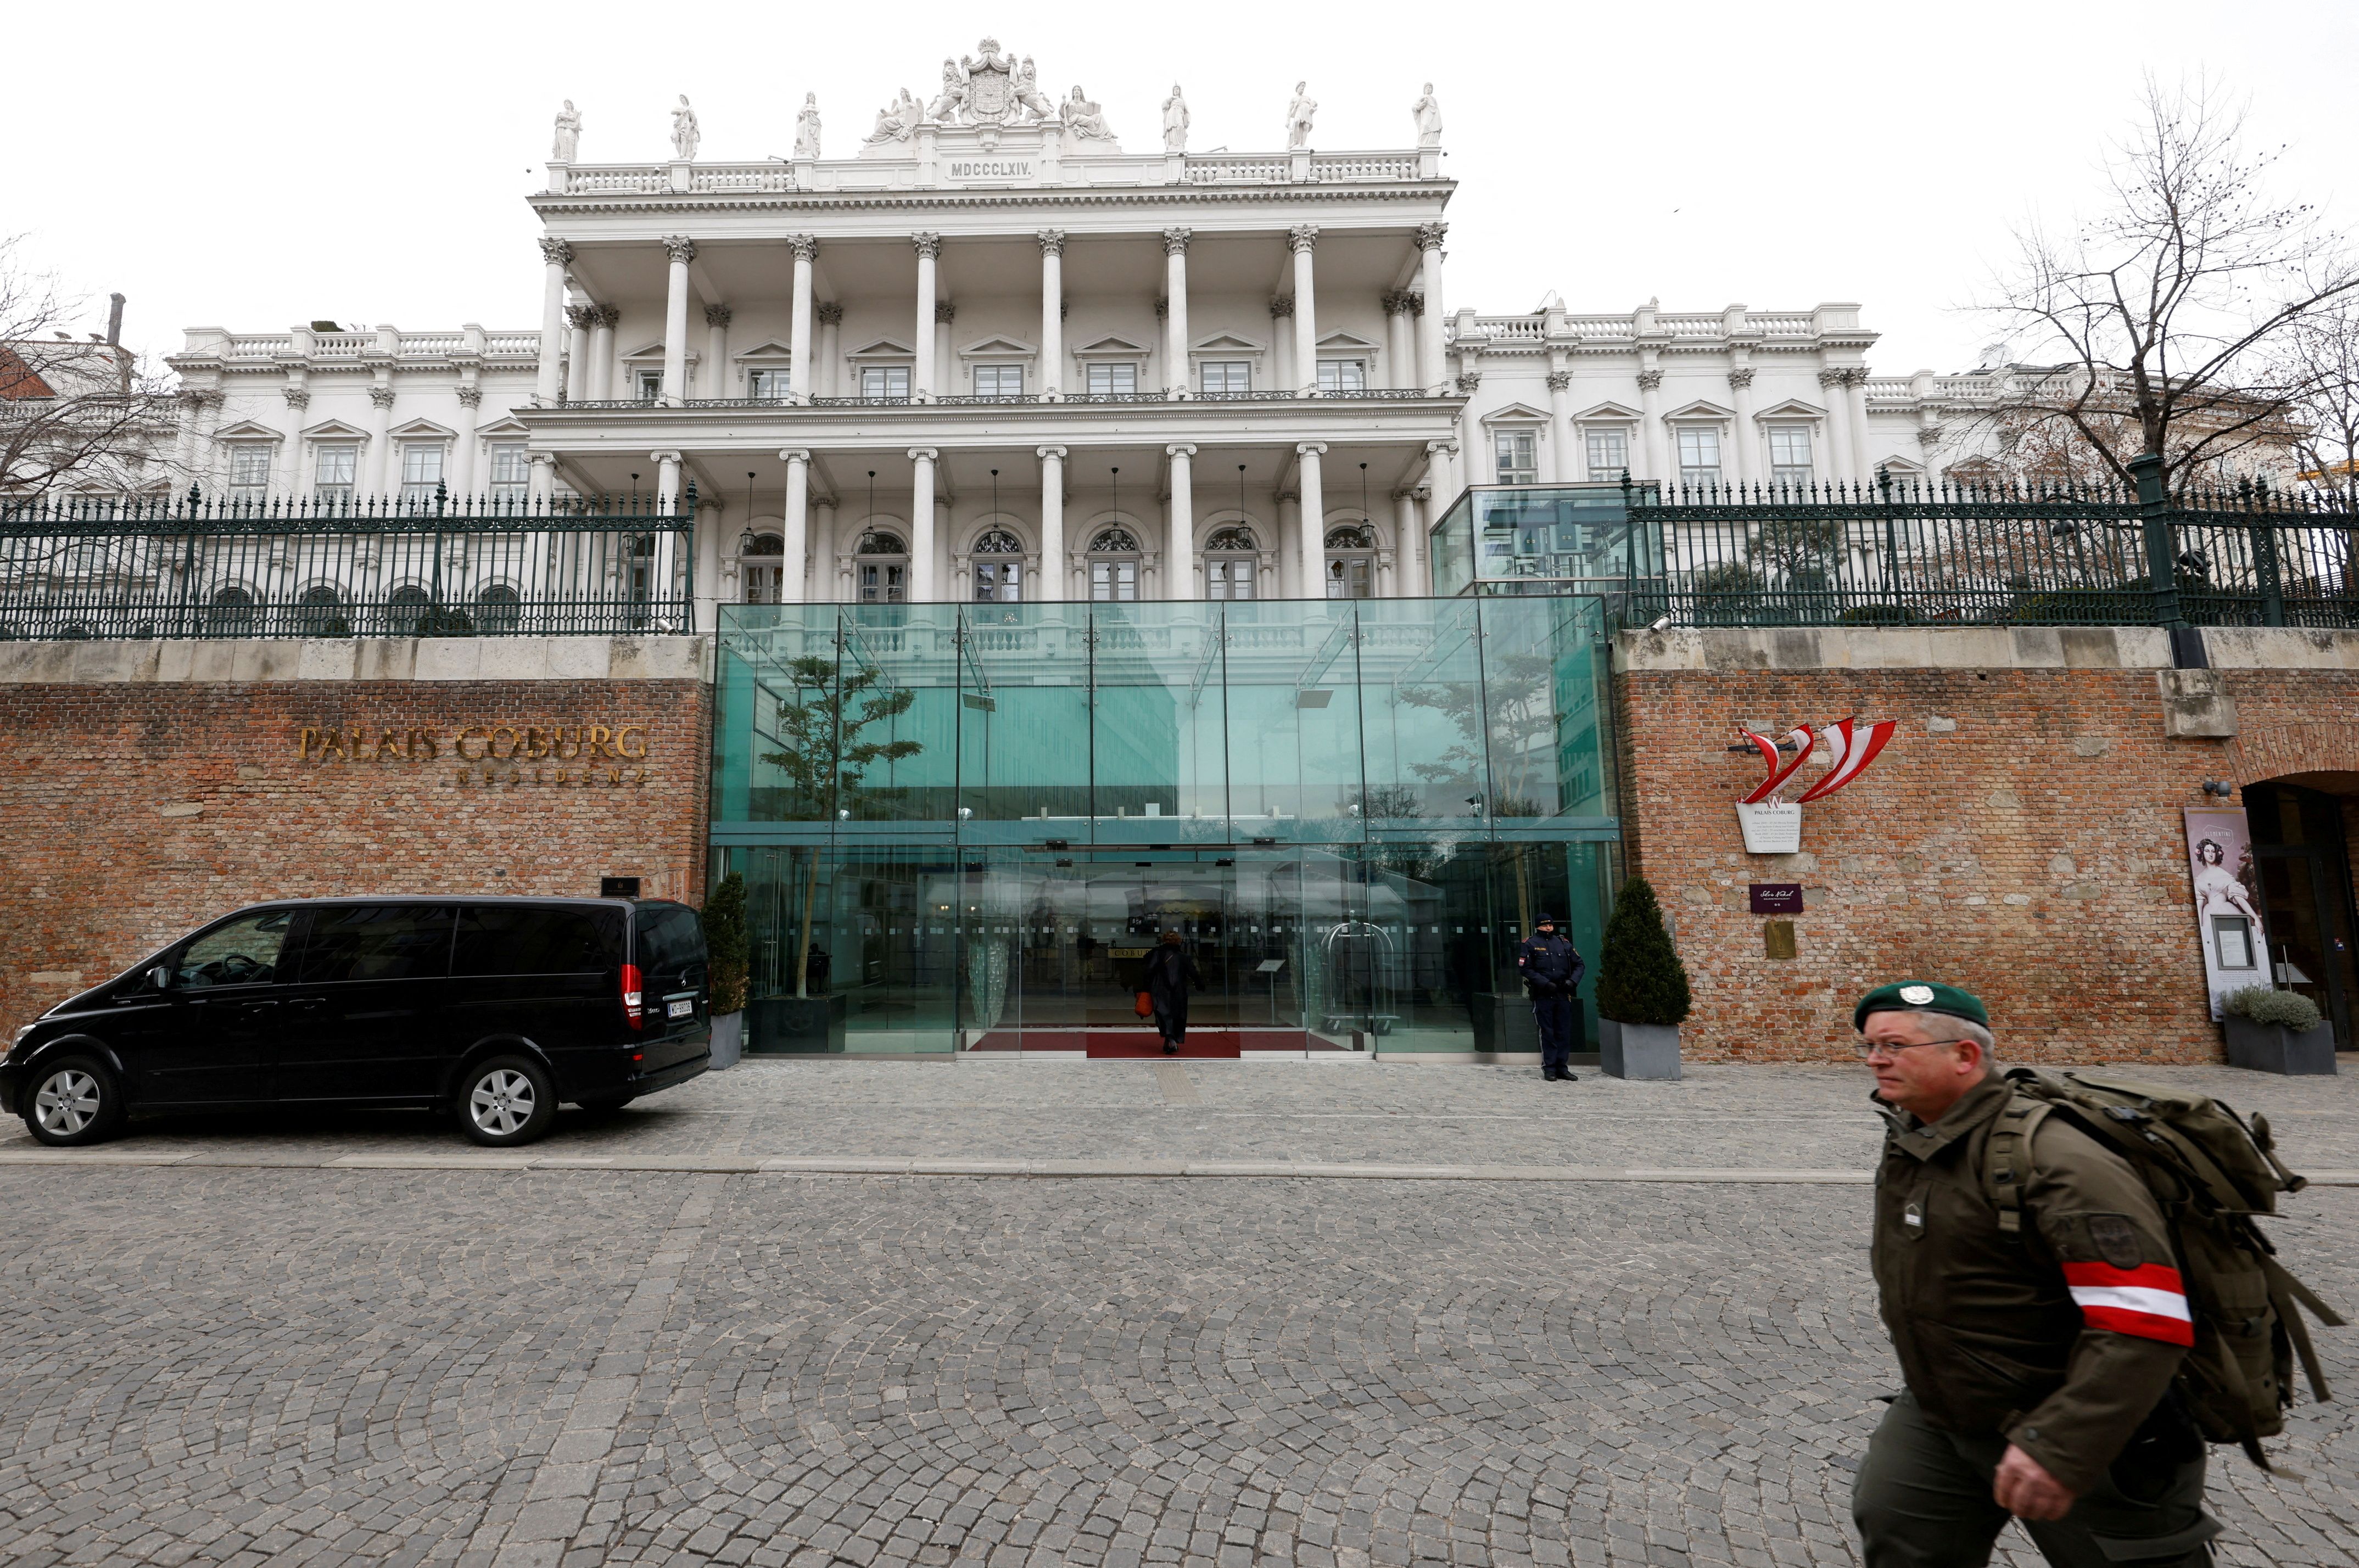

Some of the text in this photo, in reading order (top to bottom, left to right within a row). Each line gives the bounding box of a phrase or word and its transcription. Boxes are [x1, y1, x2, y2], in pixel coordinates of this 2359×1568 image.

[952, 162, 1031, 176] MDCCCLXIV.
[299, 726, 647, 759] PALAIS COBURG
[458, 769, 646, 783] RESIDENZ
